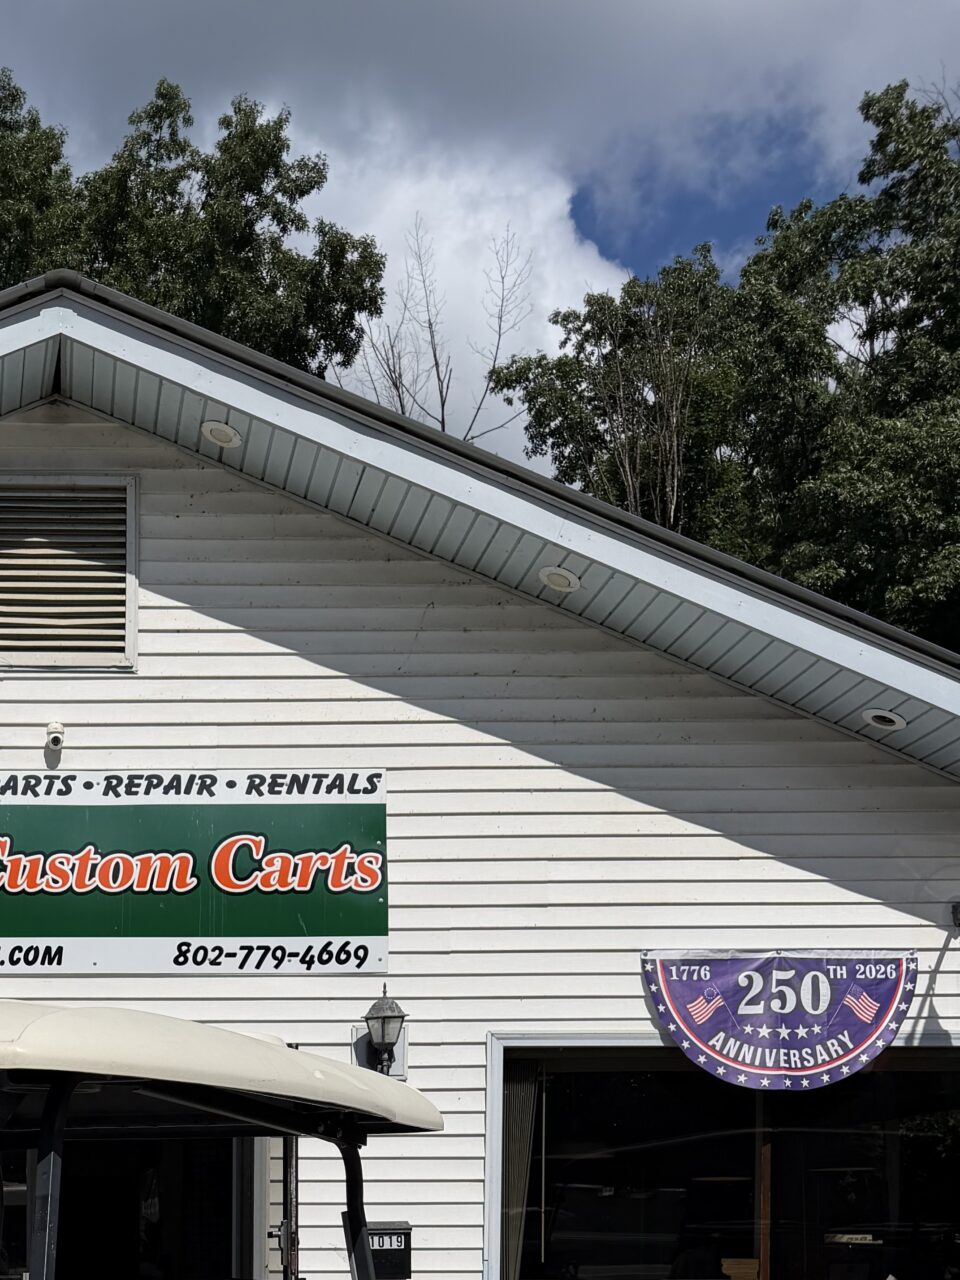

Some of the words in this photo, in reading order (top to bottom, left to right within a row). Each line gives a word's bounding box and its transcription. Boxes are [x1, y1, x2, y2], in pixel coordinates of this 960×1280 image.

[102, 774, 217, 798] REPAIR
[245, 772, 382, 796] RENTALS
[210, 834, 384, 893] Carts
[172, 940, 369, 970] 802-779-4669
[669, 965, 711, 981] 1776
[855, 963, 897, 980] 2026
[707, 1030, 854, 1069] ANNIVERSARY
[370, 1235, 403, 1248] 1019
